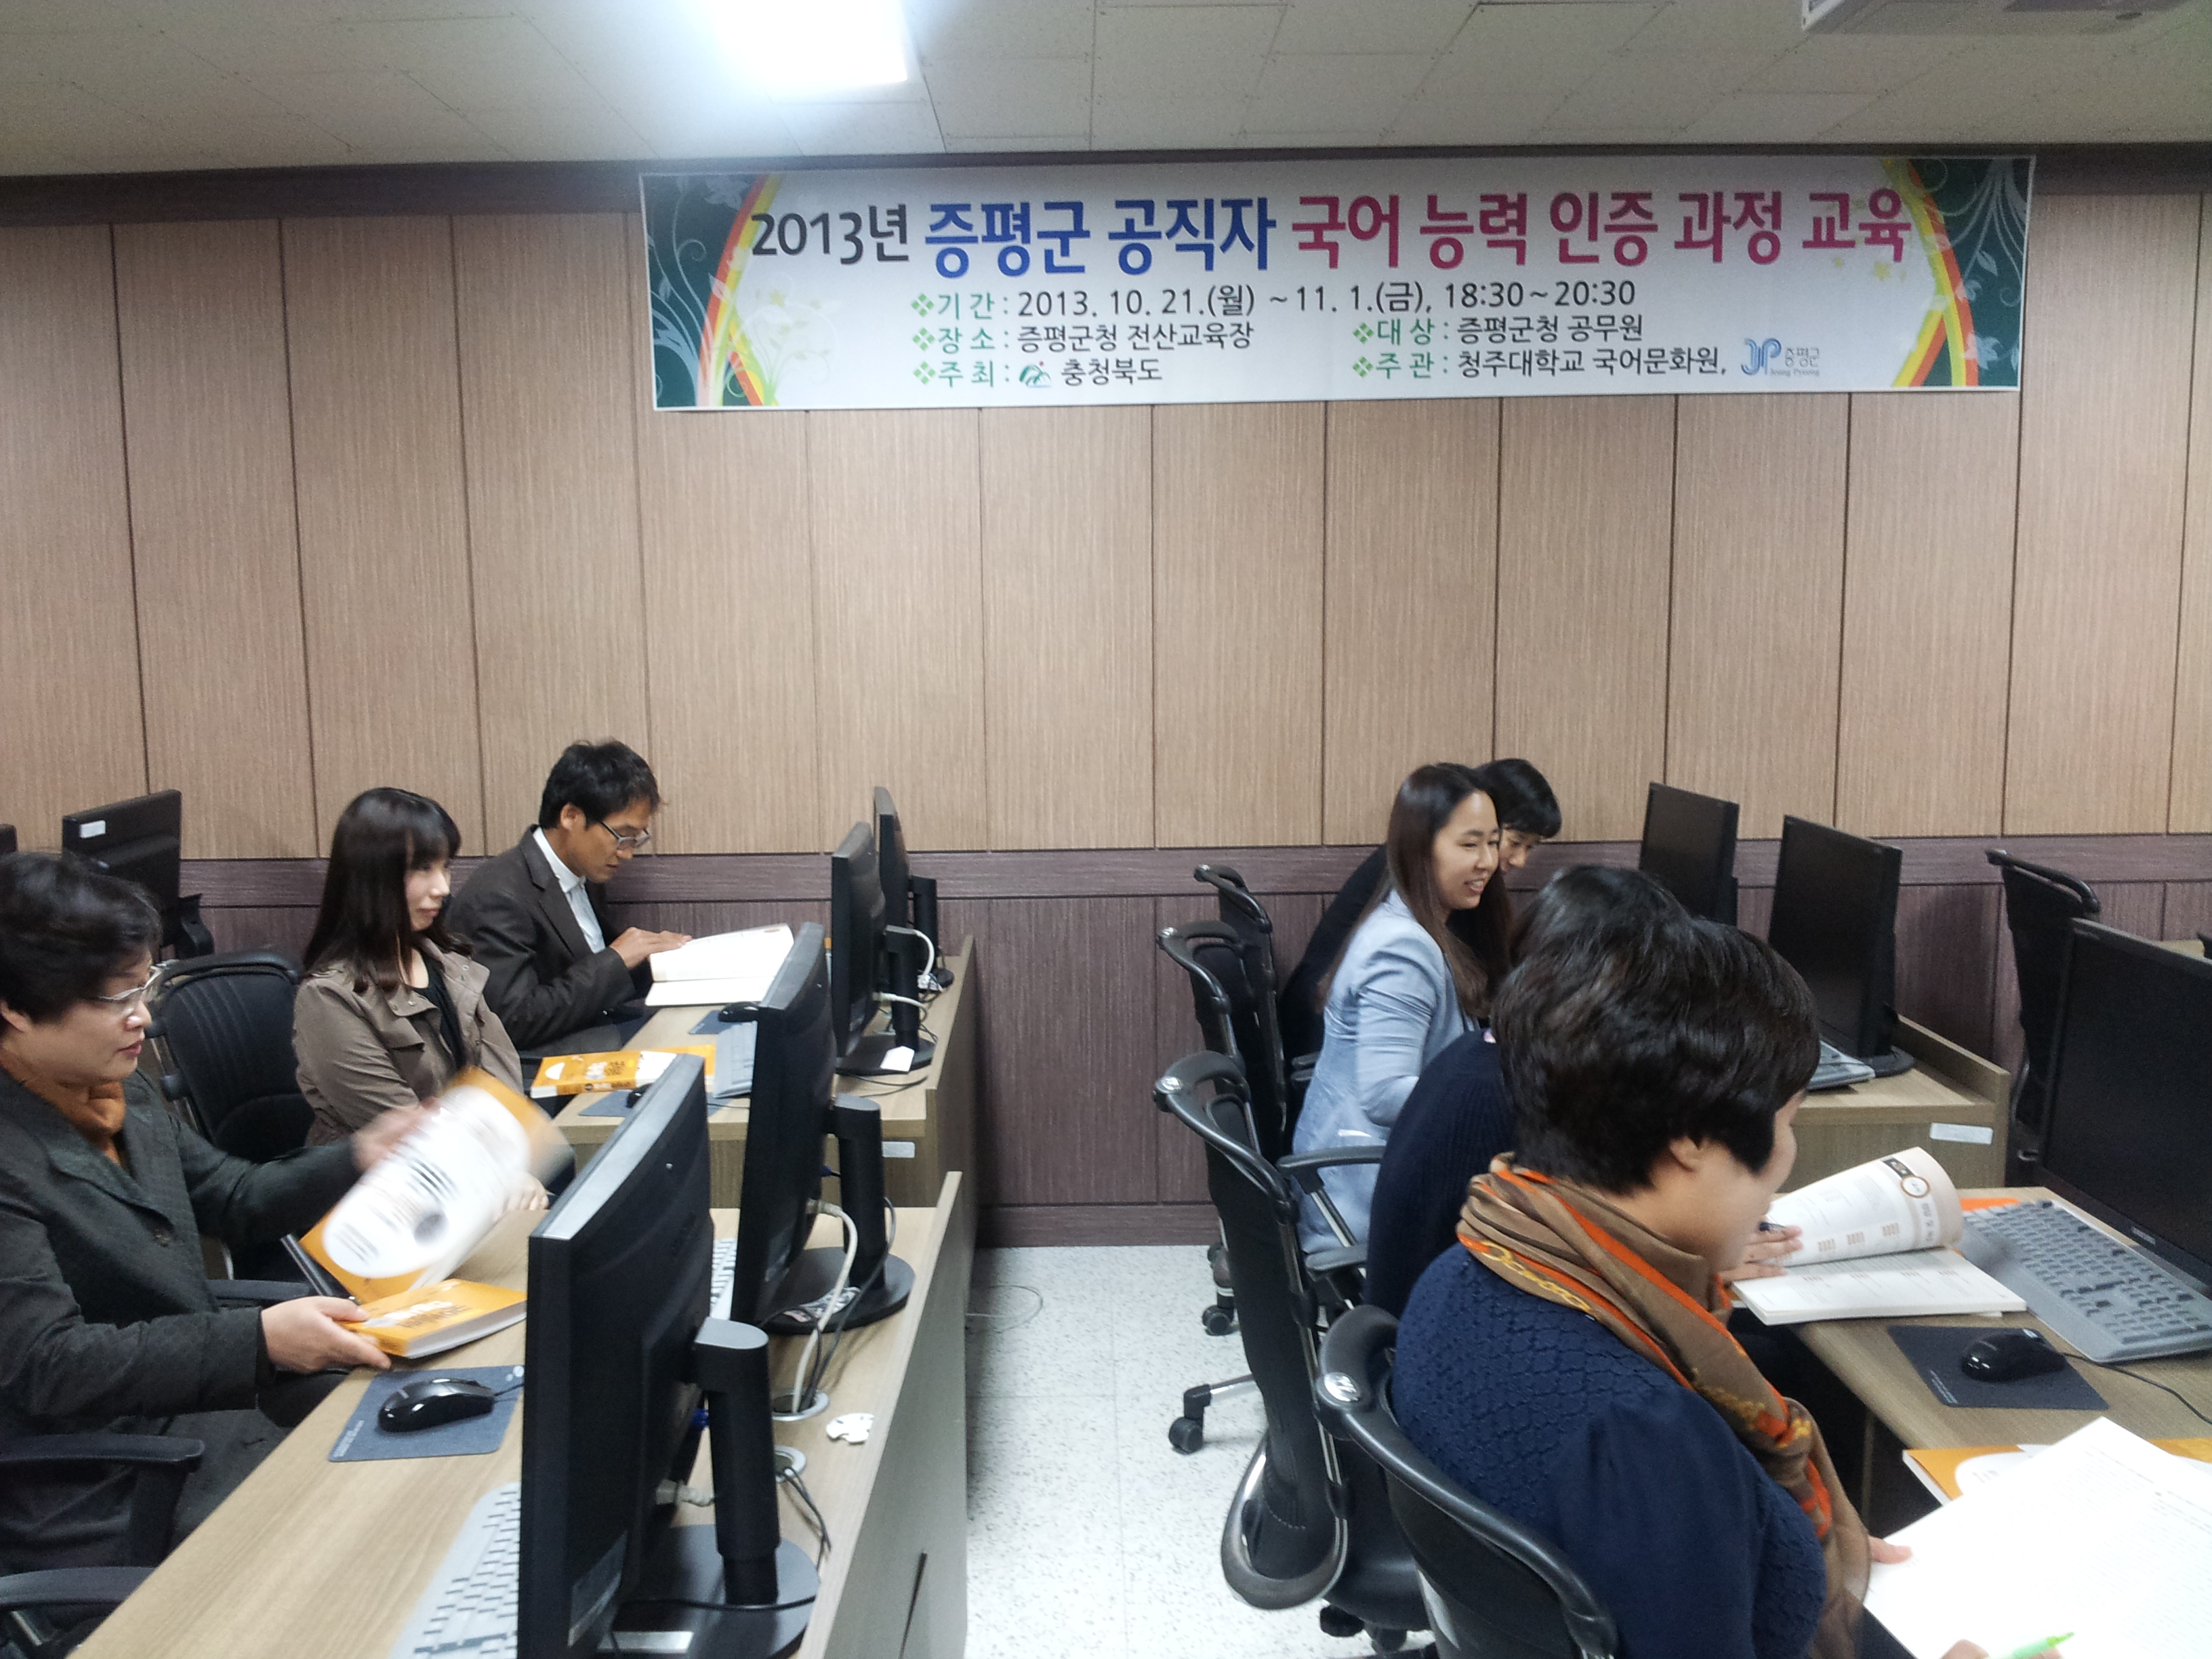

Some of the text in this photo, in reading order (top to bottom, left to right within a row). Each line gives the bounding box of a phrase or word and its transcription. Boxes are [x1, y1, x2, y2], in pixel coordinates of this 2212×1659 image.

[751, 188, 1912, 278] 2013년 증평군 공직자 국어 능력 인증 과정 교육
[1018, 325, 1116, 352] 증평군청
[1128, 321, 1254, 350] 전산교육장
[1458, 316, 1557, 344] 증평군청
[1568, 314, 1642, 342] 공무원
[1062, 358, 1162, 386] 충청북도
[1458, 349, 1584, 377] 청주대학교
